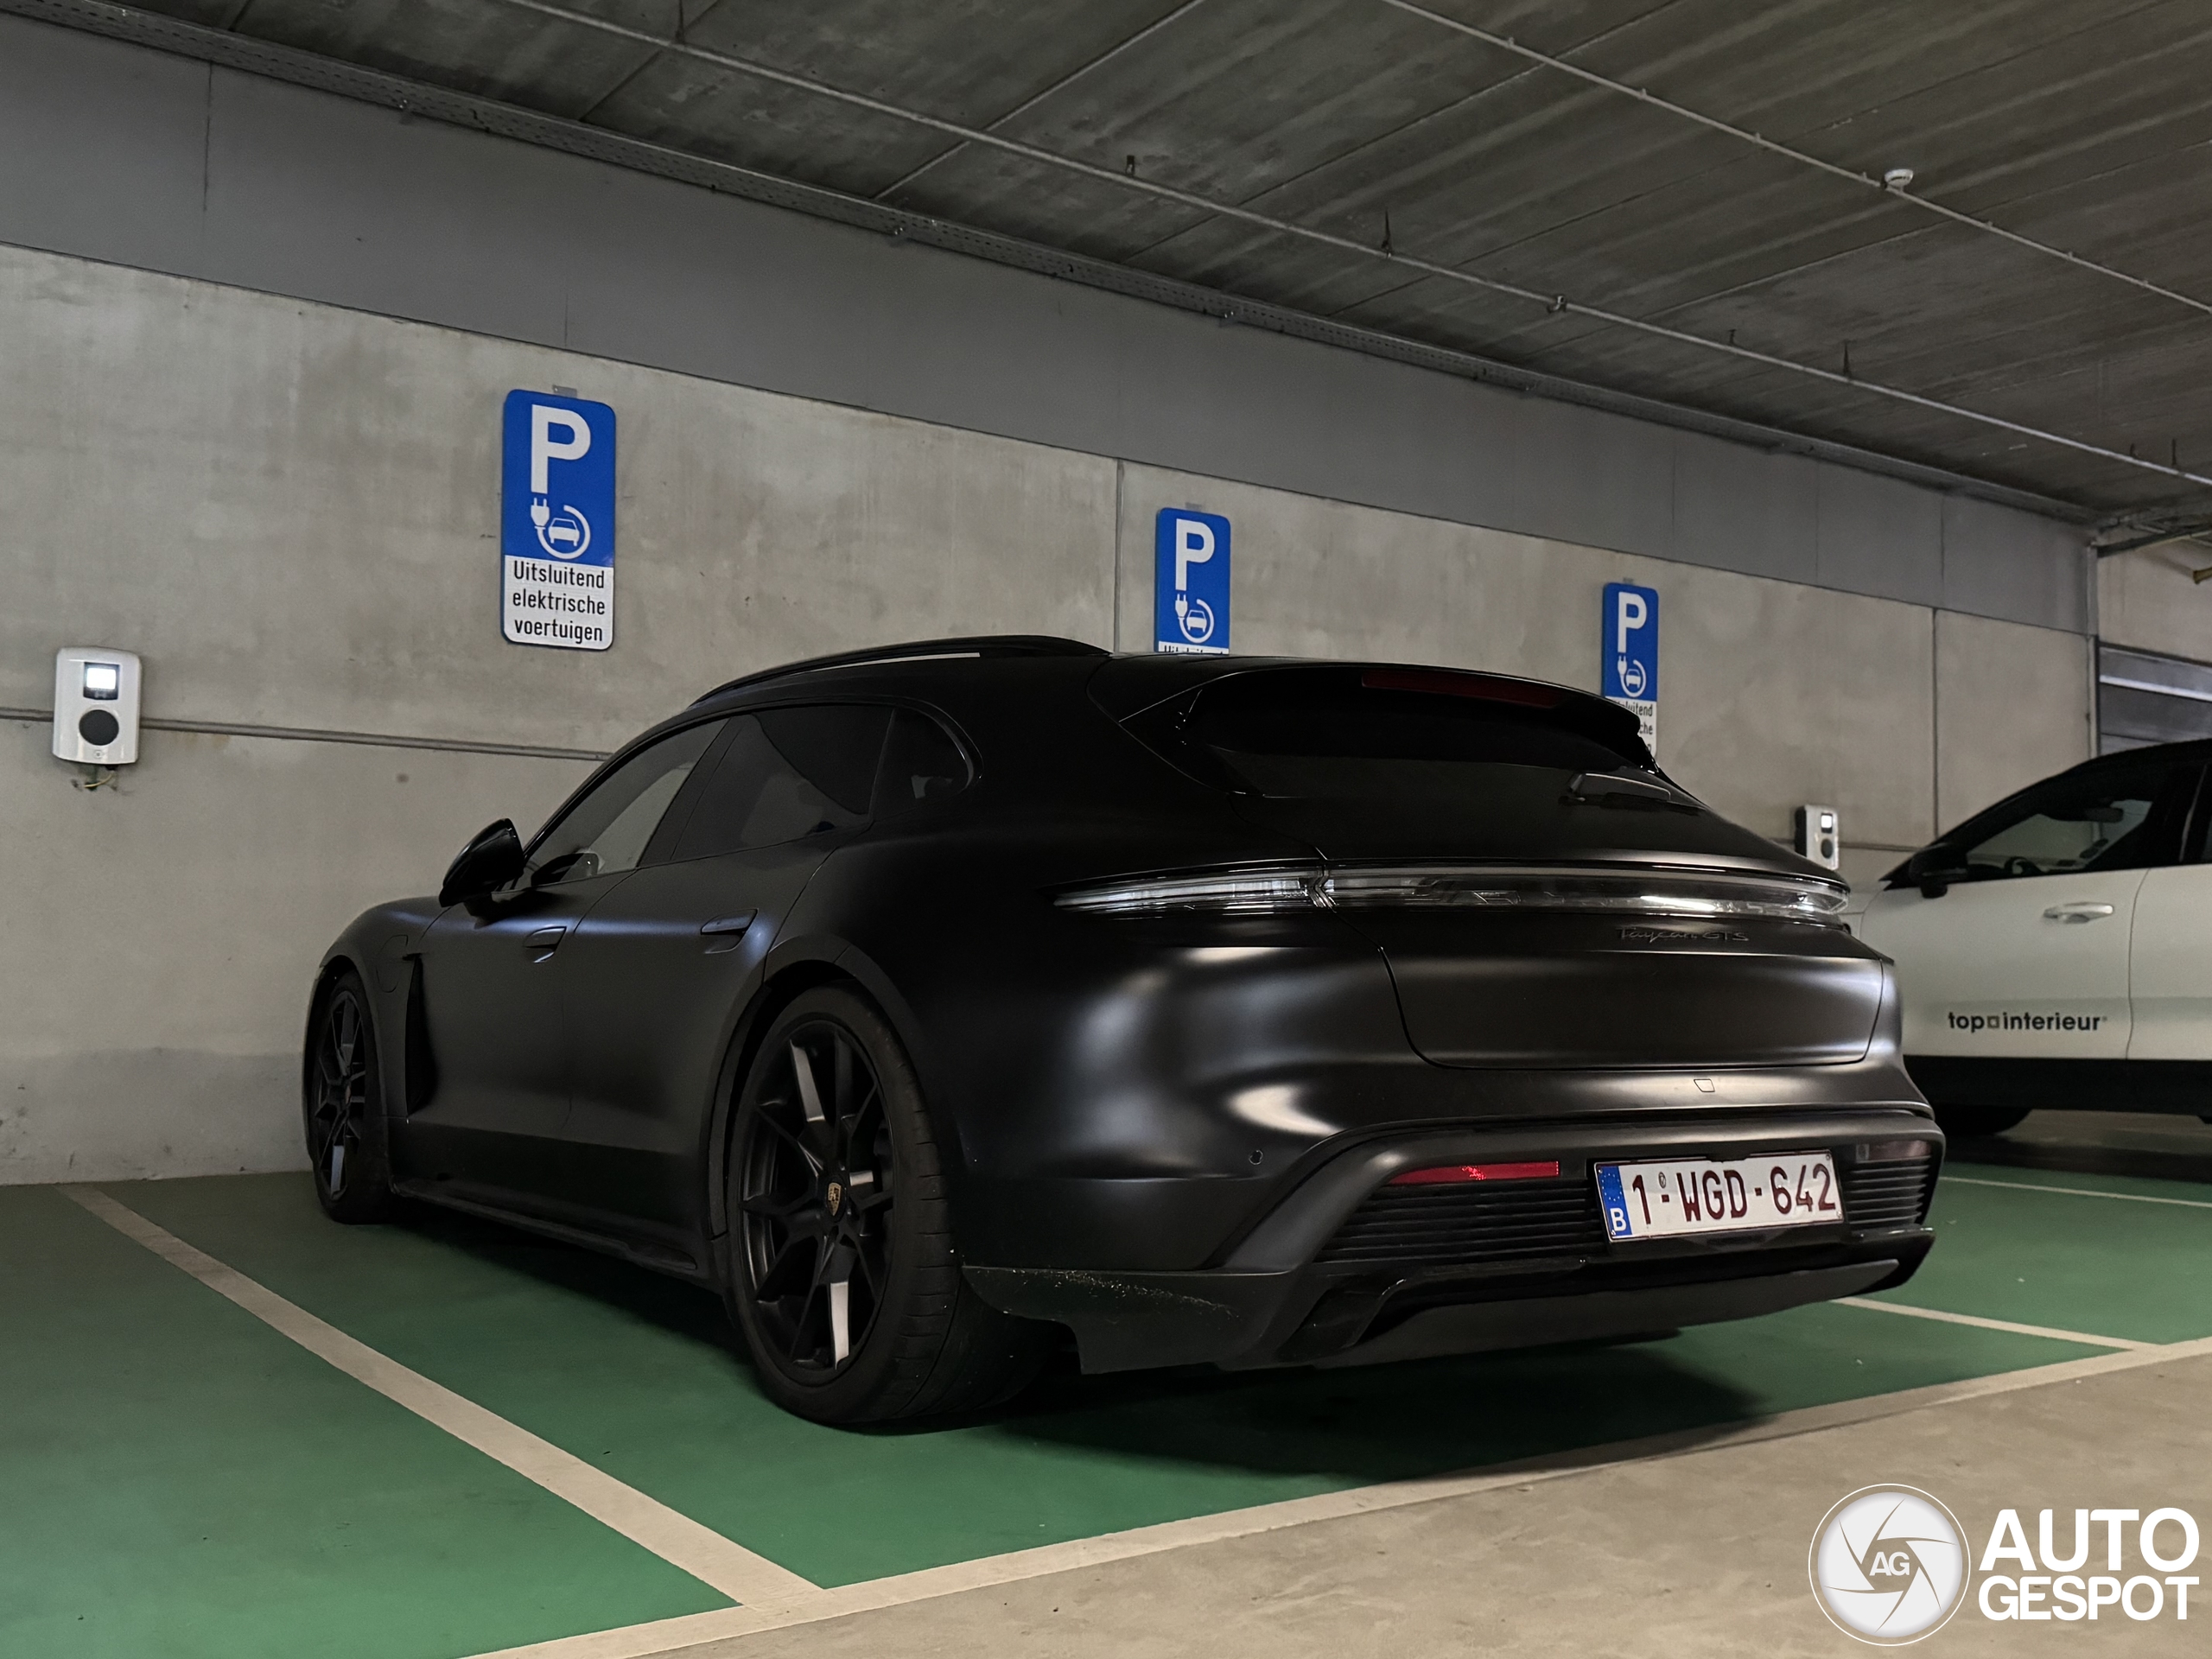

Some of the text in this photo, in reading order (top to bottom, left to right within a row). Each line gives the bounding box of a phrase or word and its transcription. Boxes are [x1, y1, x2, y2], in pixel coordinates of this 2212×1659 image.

[531, 404, 592, 495] P
[1175, 518, 1216, 592] P
[513, 560, 605, 589] Uitsluitend
[512, 588, 606, 615] elektrische
[514, 618, 603, 644] voertuigen
[1617, 591, 1648, 654] P
[1609, 1207, 1627, 1232] B
